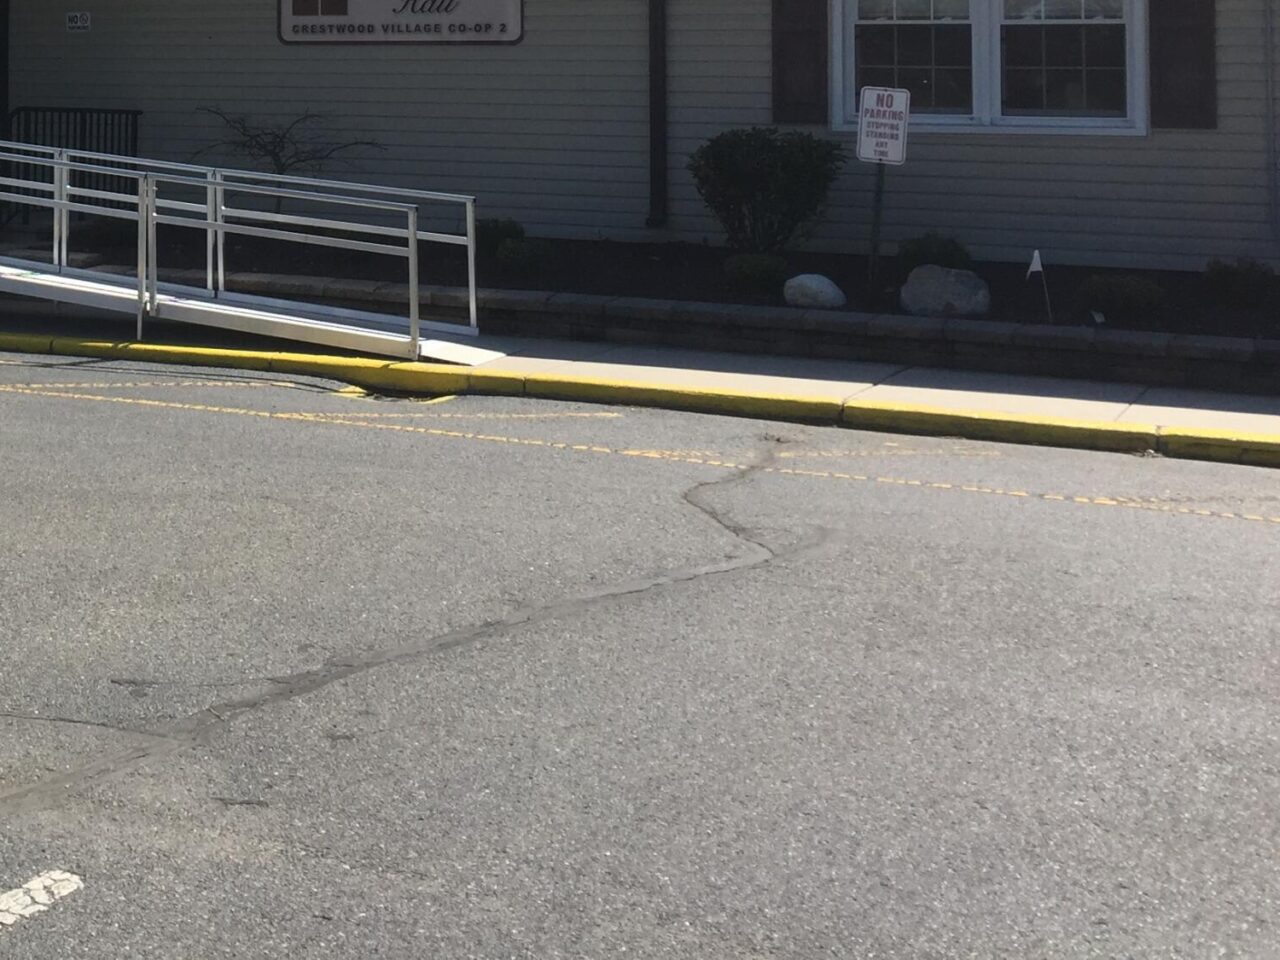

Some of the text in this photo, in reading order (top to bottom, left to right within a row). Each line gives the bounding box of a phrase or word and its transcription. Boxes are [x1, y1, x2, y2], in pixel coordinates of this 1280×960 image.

[291, 23, 508, 34] CRESTWOOD VILLAGE CO-OP 2
[876, 93, 894, 109] NO
[864, 108, 905, 121] PARKING
